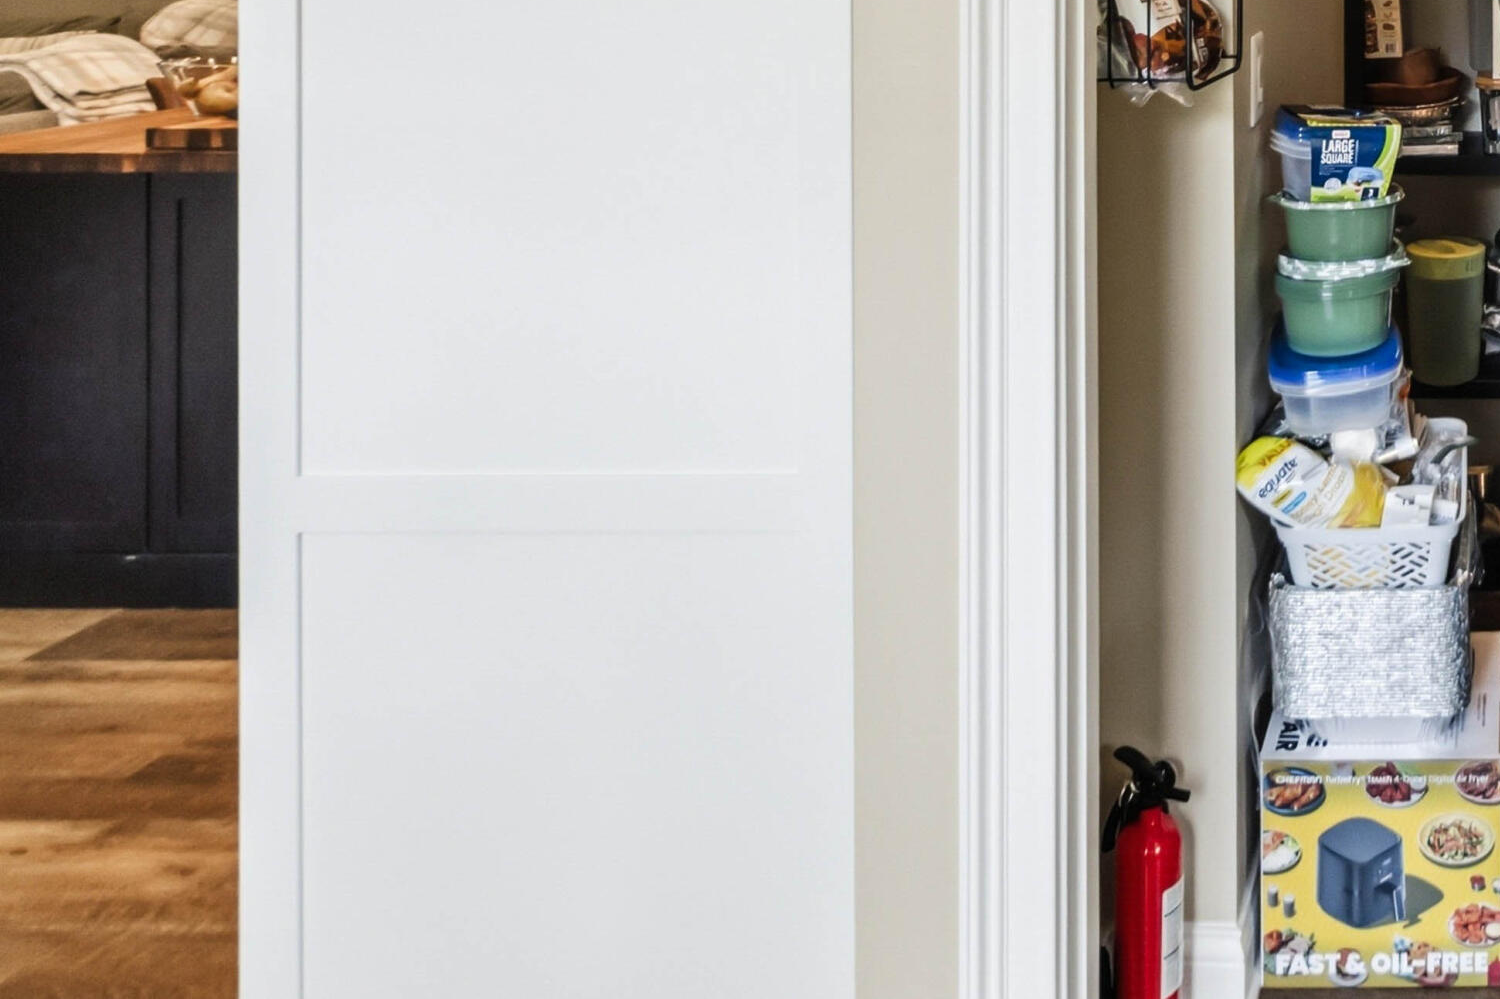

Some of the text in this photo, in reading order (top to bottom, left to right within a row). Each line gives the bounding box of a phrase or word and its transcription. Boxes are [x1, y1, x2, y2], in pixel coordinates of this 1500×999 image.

[1320, 152, 1354, 165] SQUARE
[1322, 139, 1355, 153] LARGE
[1258, 457, 1298, 498] equate
[1275, 721, 1300, 752] AIR
[1275, 951, 1489, 976] FAST & OIL-FREE
